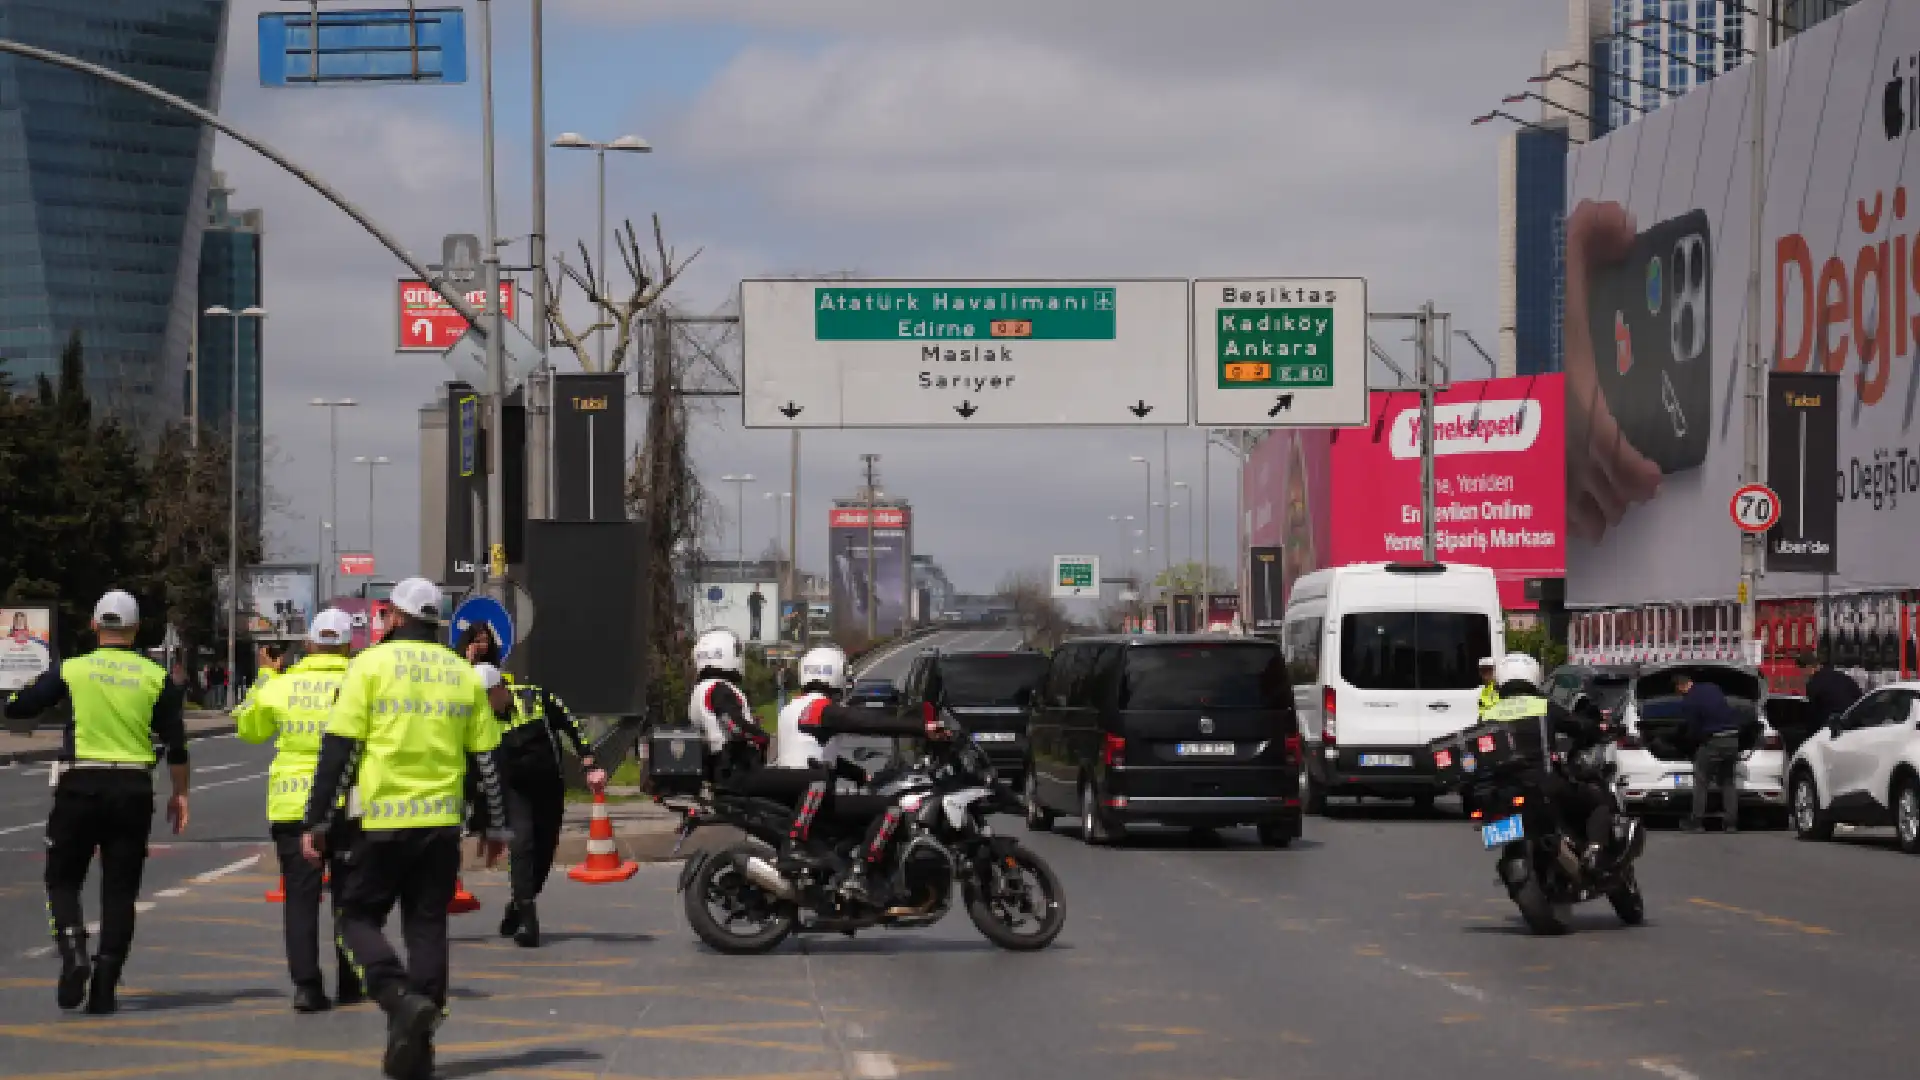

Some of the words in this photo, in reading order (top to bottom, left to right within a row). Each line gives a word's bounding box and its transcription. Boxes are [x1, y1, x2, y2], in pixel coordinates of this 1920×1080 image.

[819, 290, 920, 311] Atatürk
[898, 318, 976, 338] Edirne
[1222, 312, 1328, 336] Kadıköy
[920, 345, 1013, 362] Maslak
[1223, 338, 1318, 356] Ankara
[918, 371, 1016, 391] Sarıyer
[1401, 504, 1421, 523] En
[1435, 501, 1479, 523] evilen
[1481, 499, 1533, 520] Online
[1740, 496, 1770, 521] 70
